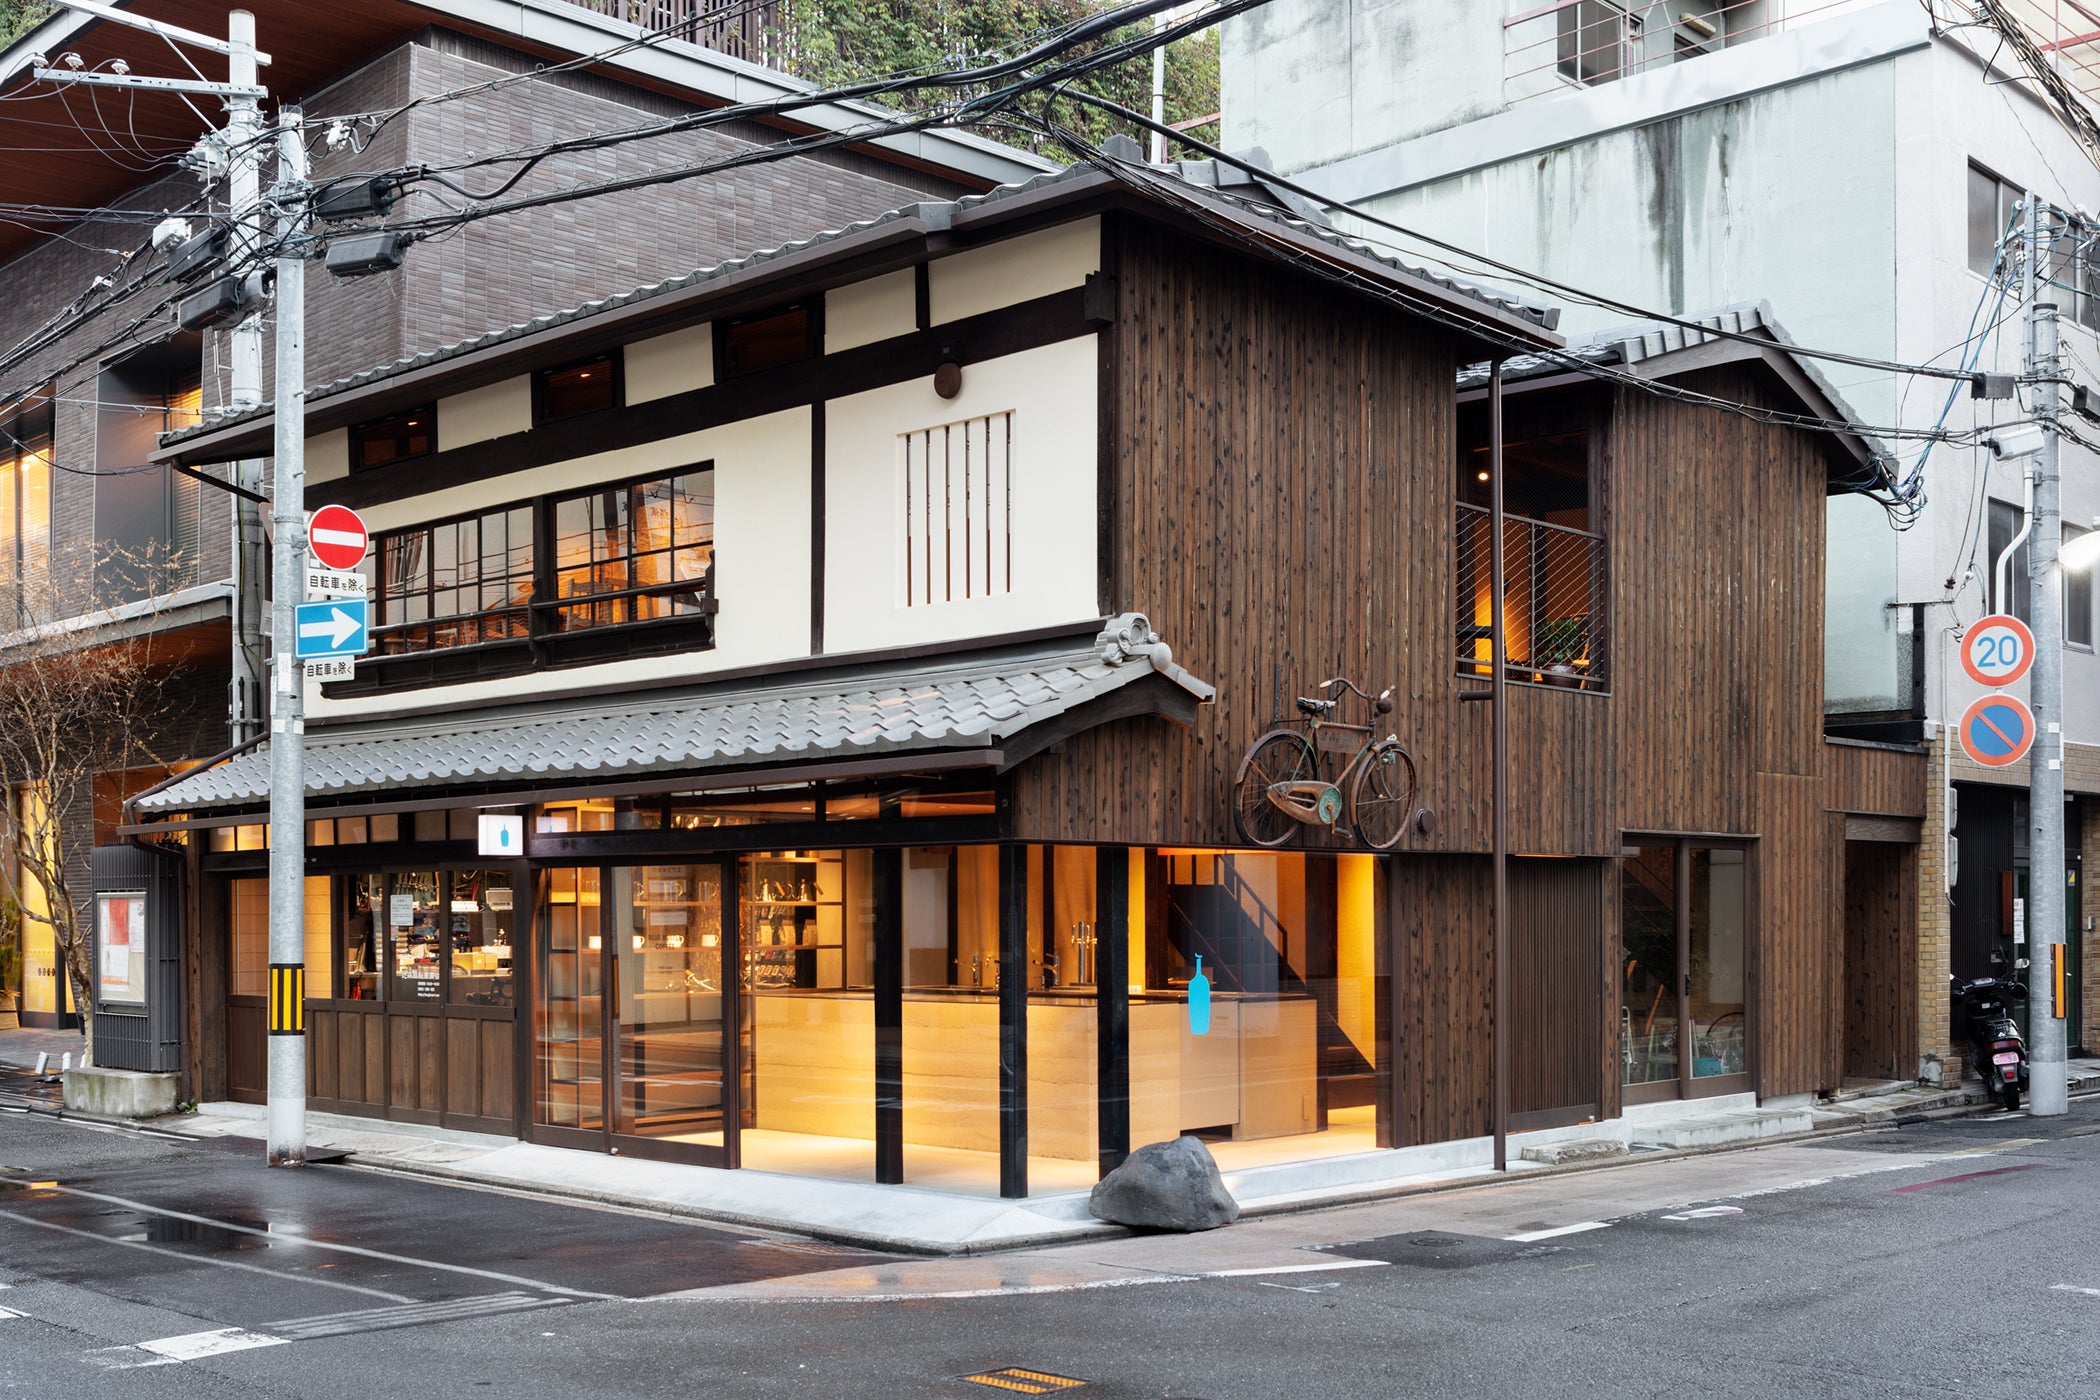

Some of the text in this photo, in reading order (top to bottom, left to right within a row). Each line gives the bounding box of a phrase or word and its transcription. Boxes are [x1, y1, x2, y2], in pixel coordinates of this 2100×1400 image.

[309, 575, 364, 592] 自転車を除く
[1977, 635, 2017, 667] 20
[307, 661, 352, 677] 自転車を除く
